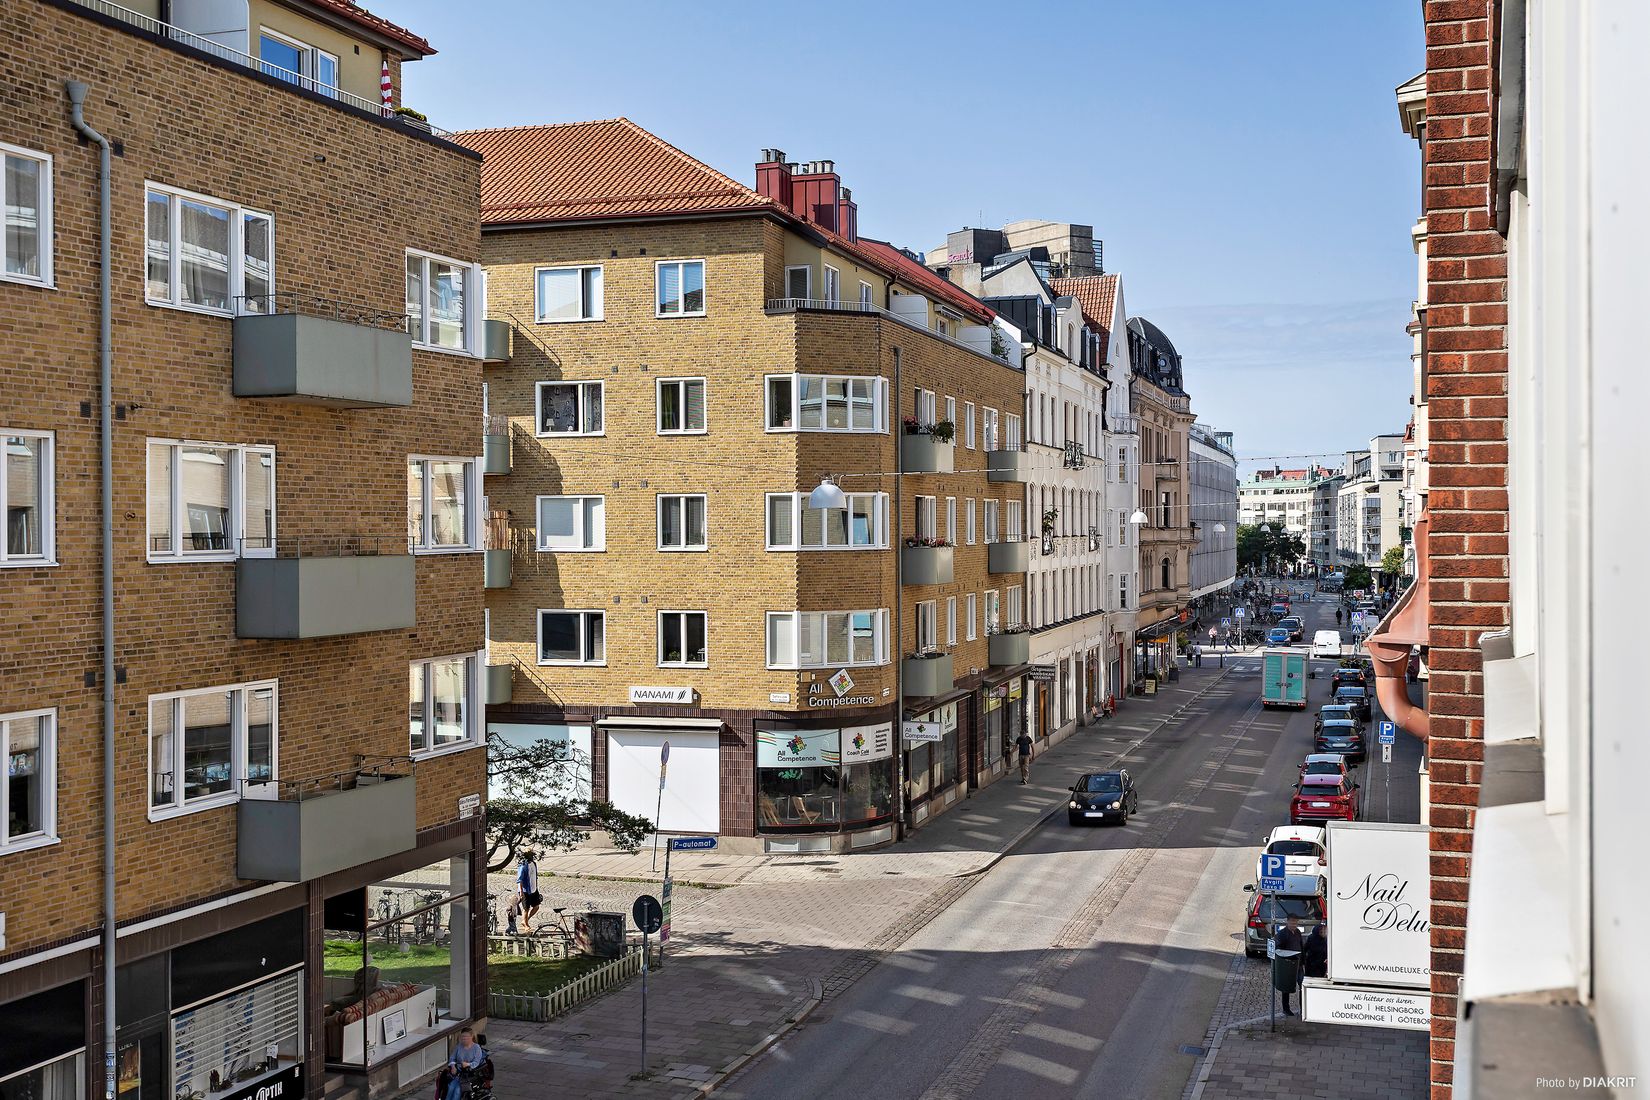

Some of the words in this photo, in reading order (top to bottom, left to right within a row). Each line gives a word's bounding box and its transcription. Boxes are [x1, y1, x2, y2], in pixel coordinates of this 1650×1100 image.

[809, 683, 823, 694] All
[634, 690, 674, 700] NANAMI
[809, 696, 875, 708] Competence
[1383, 723, 1392, 735] P
[904, 732, 938, 740] Competence
[777, 755, 817, 763] Competence
[674, 840, 711, 848] P-automat
[1267, 856, 1281, 876] P
[1337, 873, 1408, 902] Nail
[1360, 902, 1431, 932] Delu
[1353, 964, 1431, 974] WWW.NAILDELUXE.C
[1363, 994, 1384, 1002] hittar
[1375, 1005, 1424, 1015] HELSINGBORG
[1331, 1011, 1385, 1022] LÖDDEKÖPINGE
